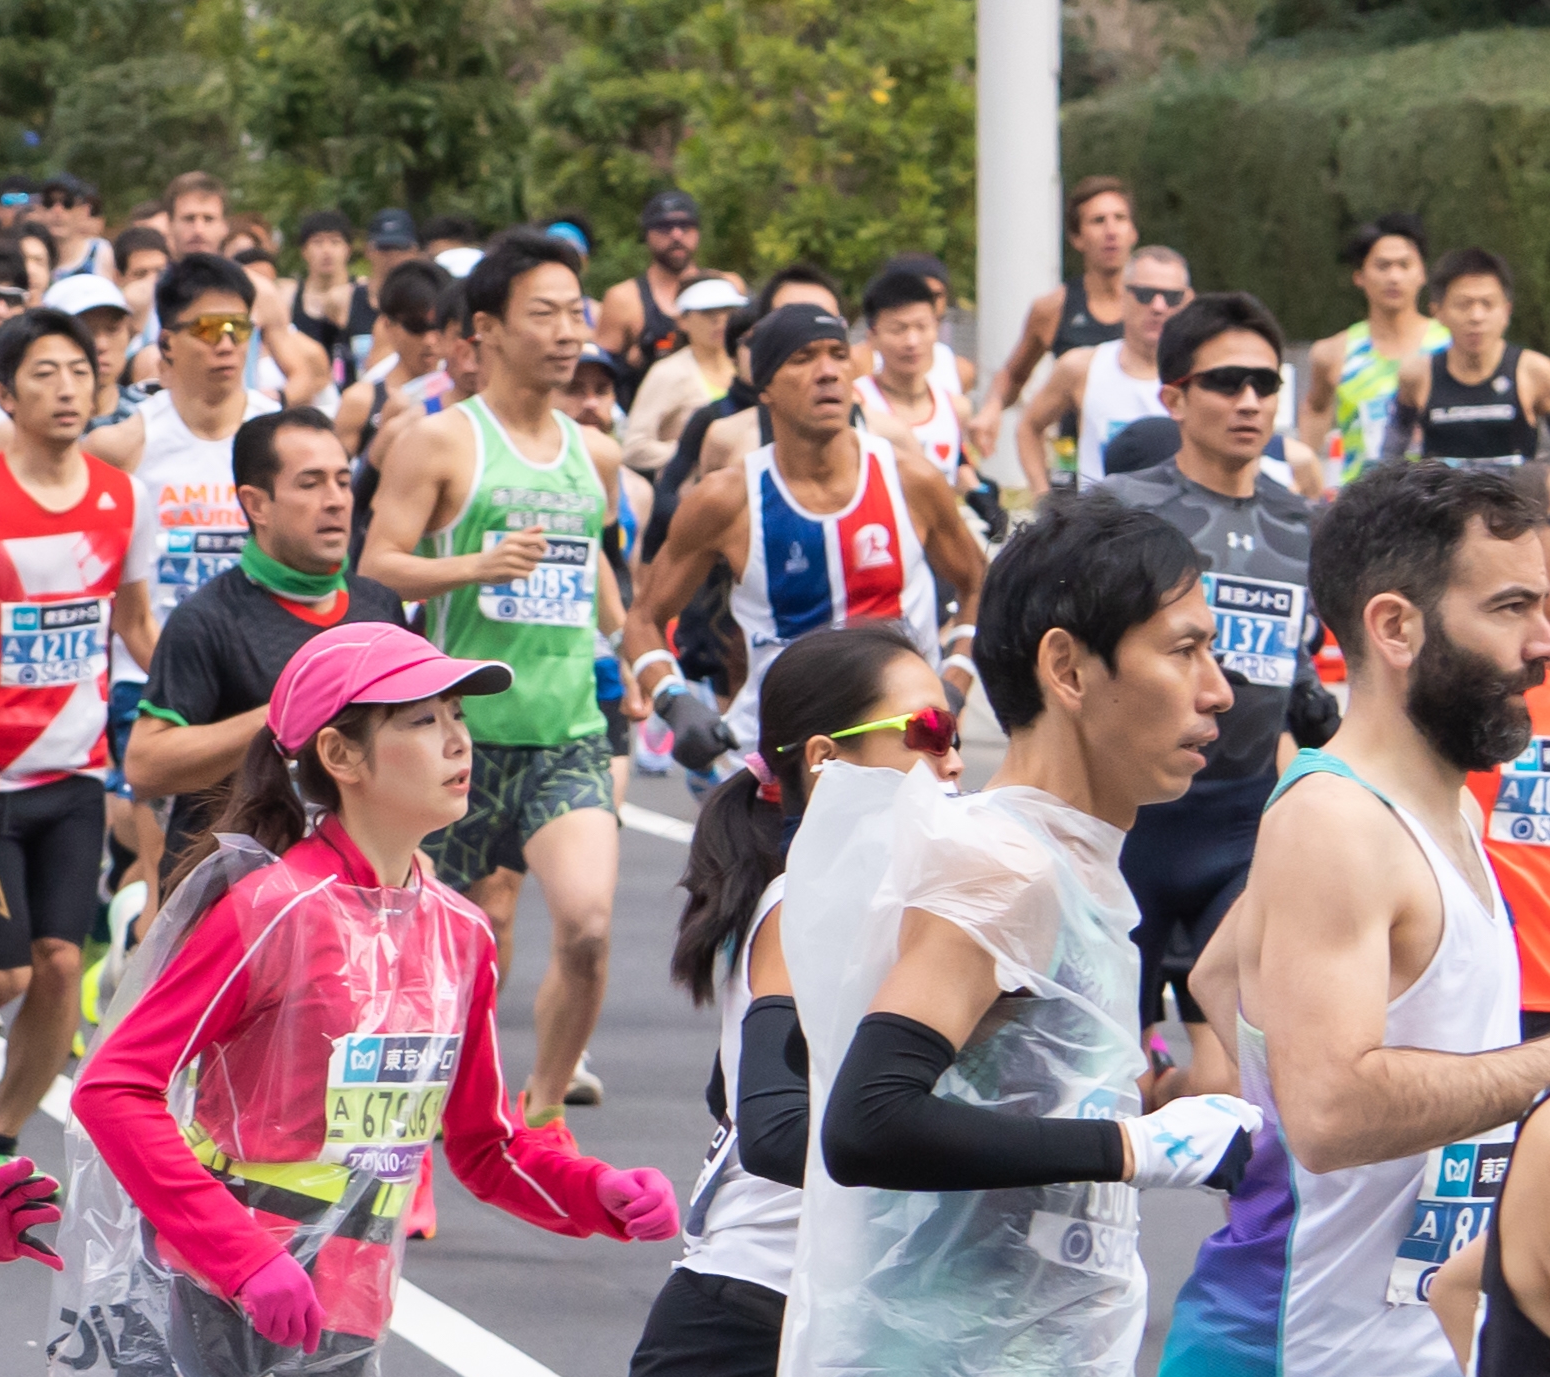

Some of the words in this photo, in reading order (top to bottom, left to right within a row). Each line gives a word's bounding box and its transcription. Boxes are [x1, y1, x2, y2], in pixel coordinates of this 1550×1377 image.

[31, 629, 89, 663] 4216
[1221, 615, 1273, 654] 137
[334, 1095, 350, 1121] A
[1414, 1210, 1438, 1238] A
